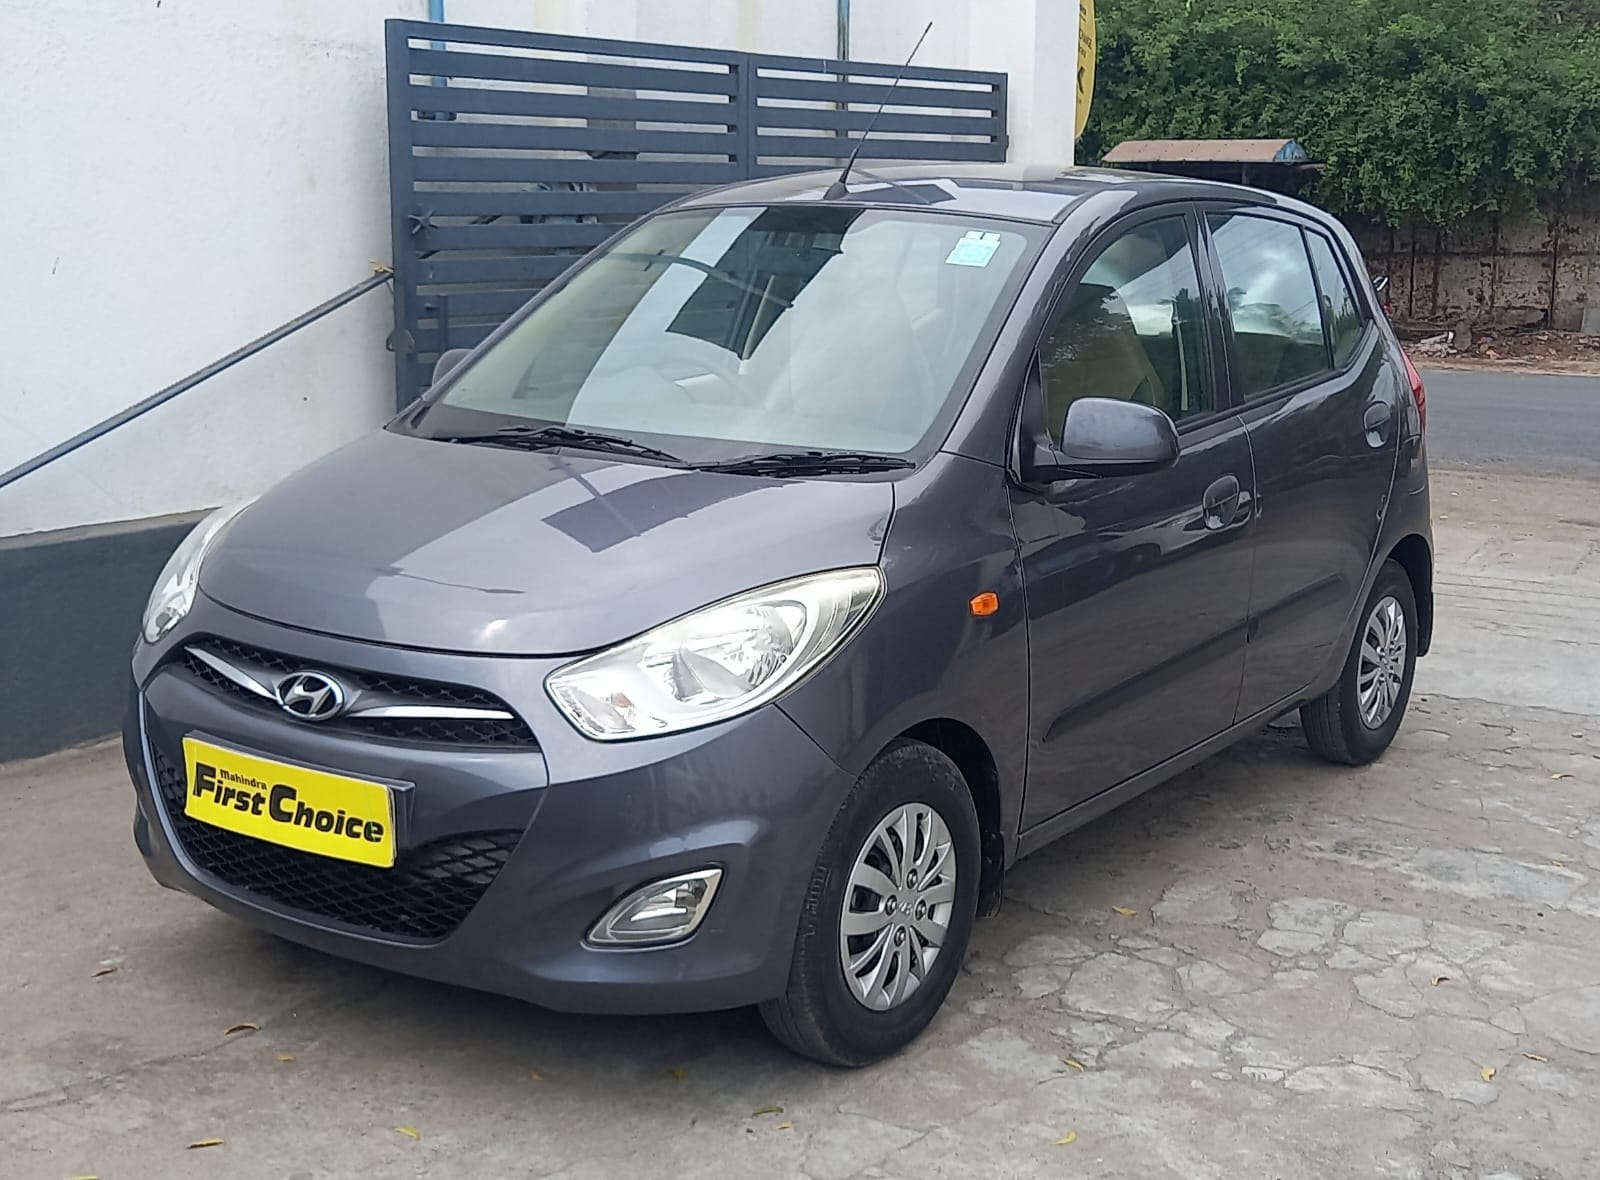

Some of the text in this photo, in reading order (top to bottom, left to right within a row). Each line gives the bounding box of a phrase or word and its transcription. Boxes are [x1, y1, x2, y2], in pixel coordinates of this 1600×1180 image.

[193, 761, 384, 843] First Choice
[219, 768, 267, 790] Mahindra
